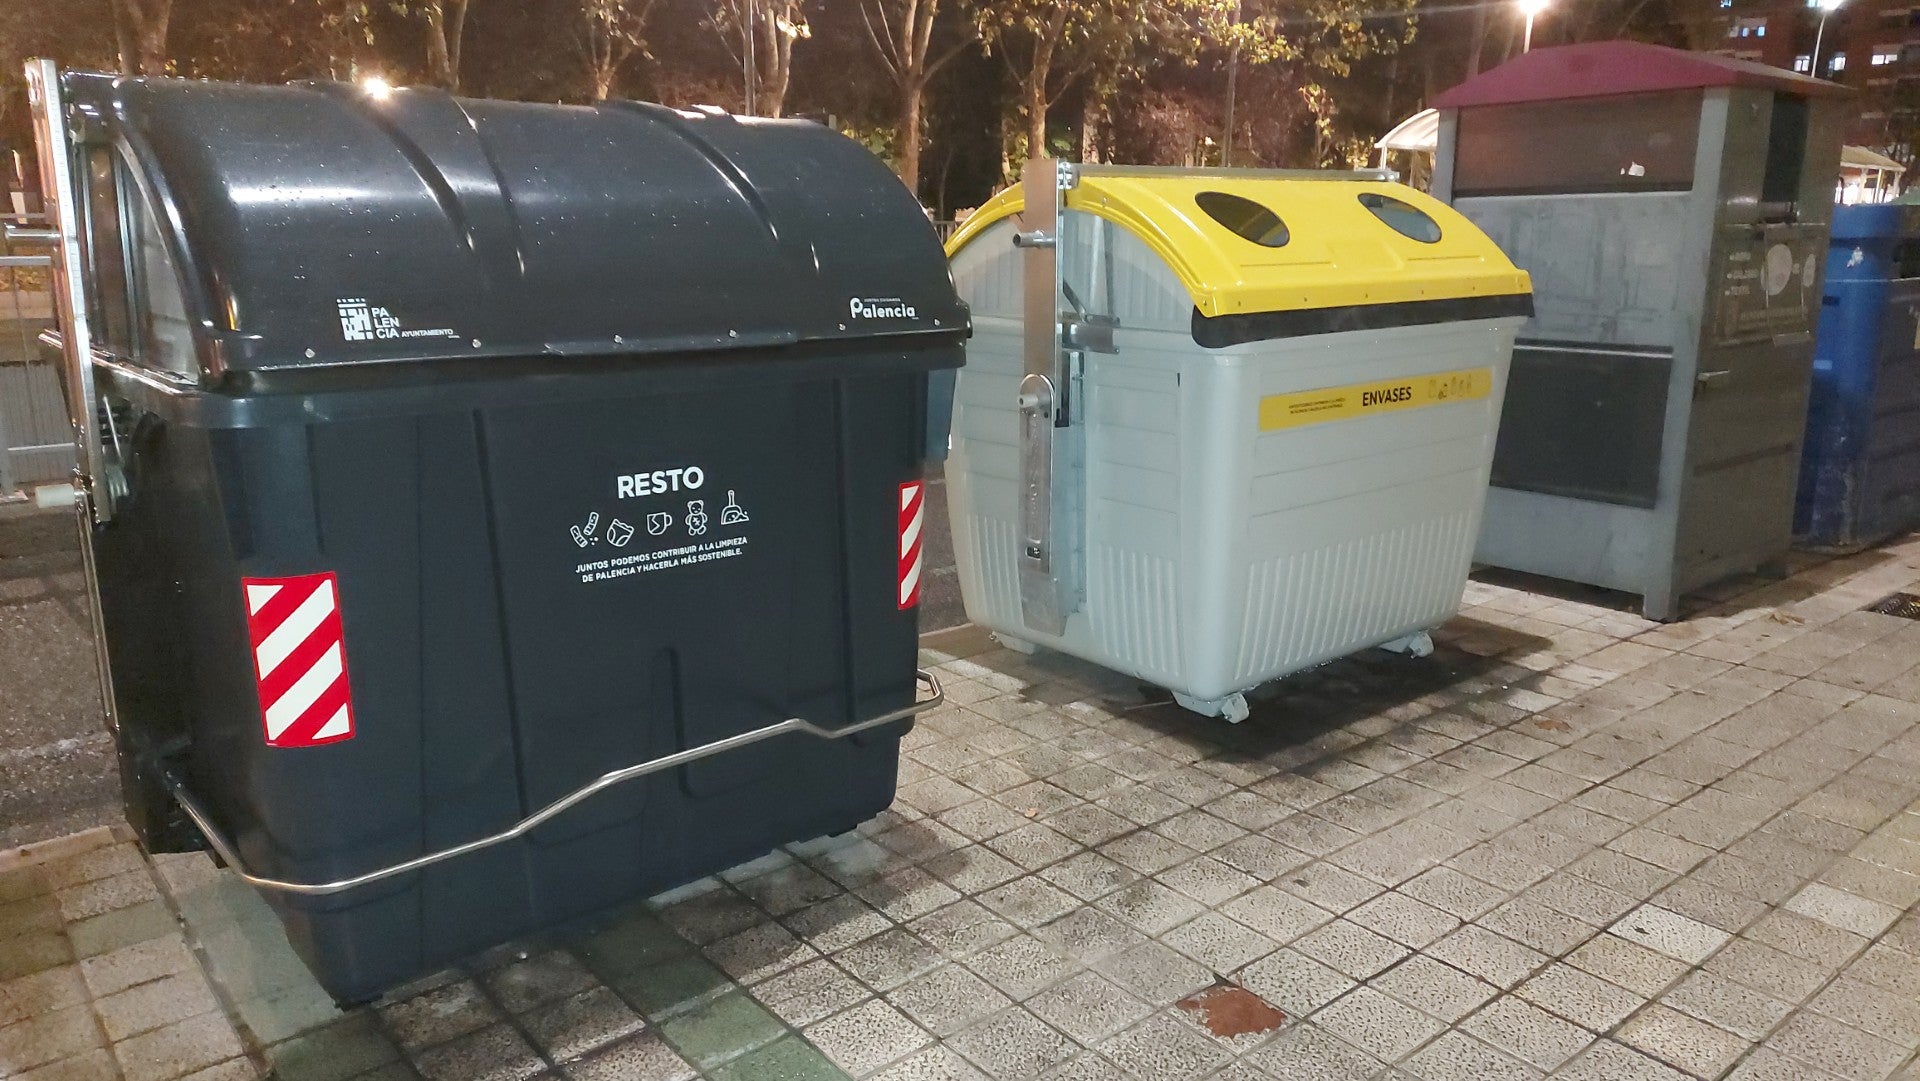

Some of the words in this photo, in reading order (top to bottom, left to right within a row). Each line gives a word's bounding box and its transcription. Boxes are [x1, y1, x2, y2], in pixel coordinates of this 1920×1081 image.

[371, 307, 389, 318] PA
[850, 297, 915, 318] Palencia
[374, 317, 400, 328] LEN
[376, 328, 399, 339] CIA
[401, 328, 454, 337] AYUNTAMIENTO
[1362, 386, 1412, 407] ENVASES
[617, 466, 704, 499] RESTO
[575, 560, 609, 573] JUNTOS
[611, 553, 650, 567] PODEMOS
[651, 545, 697, 560] CONTRIBUIR
[698, 544, 705, 552] A
[705, 542, 715, 551] LA
[715, 536, 748, 549] LIMPIEZA
[582, 573, 594, 583] DE
[595, 567, 636, 581] PALENCIA
[636, 565, 643, 573] Y
[643, 558, 679, 572] HACERLA
[680, 554, 697, 565] MÁS
[698, 547, 743, 562] SOSTENIBLE.
